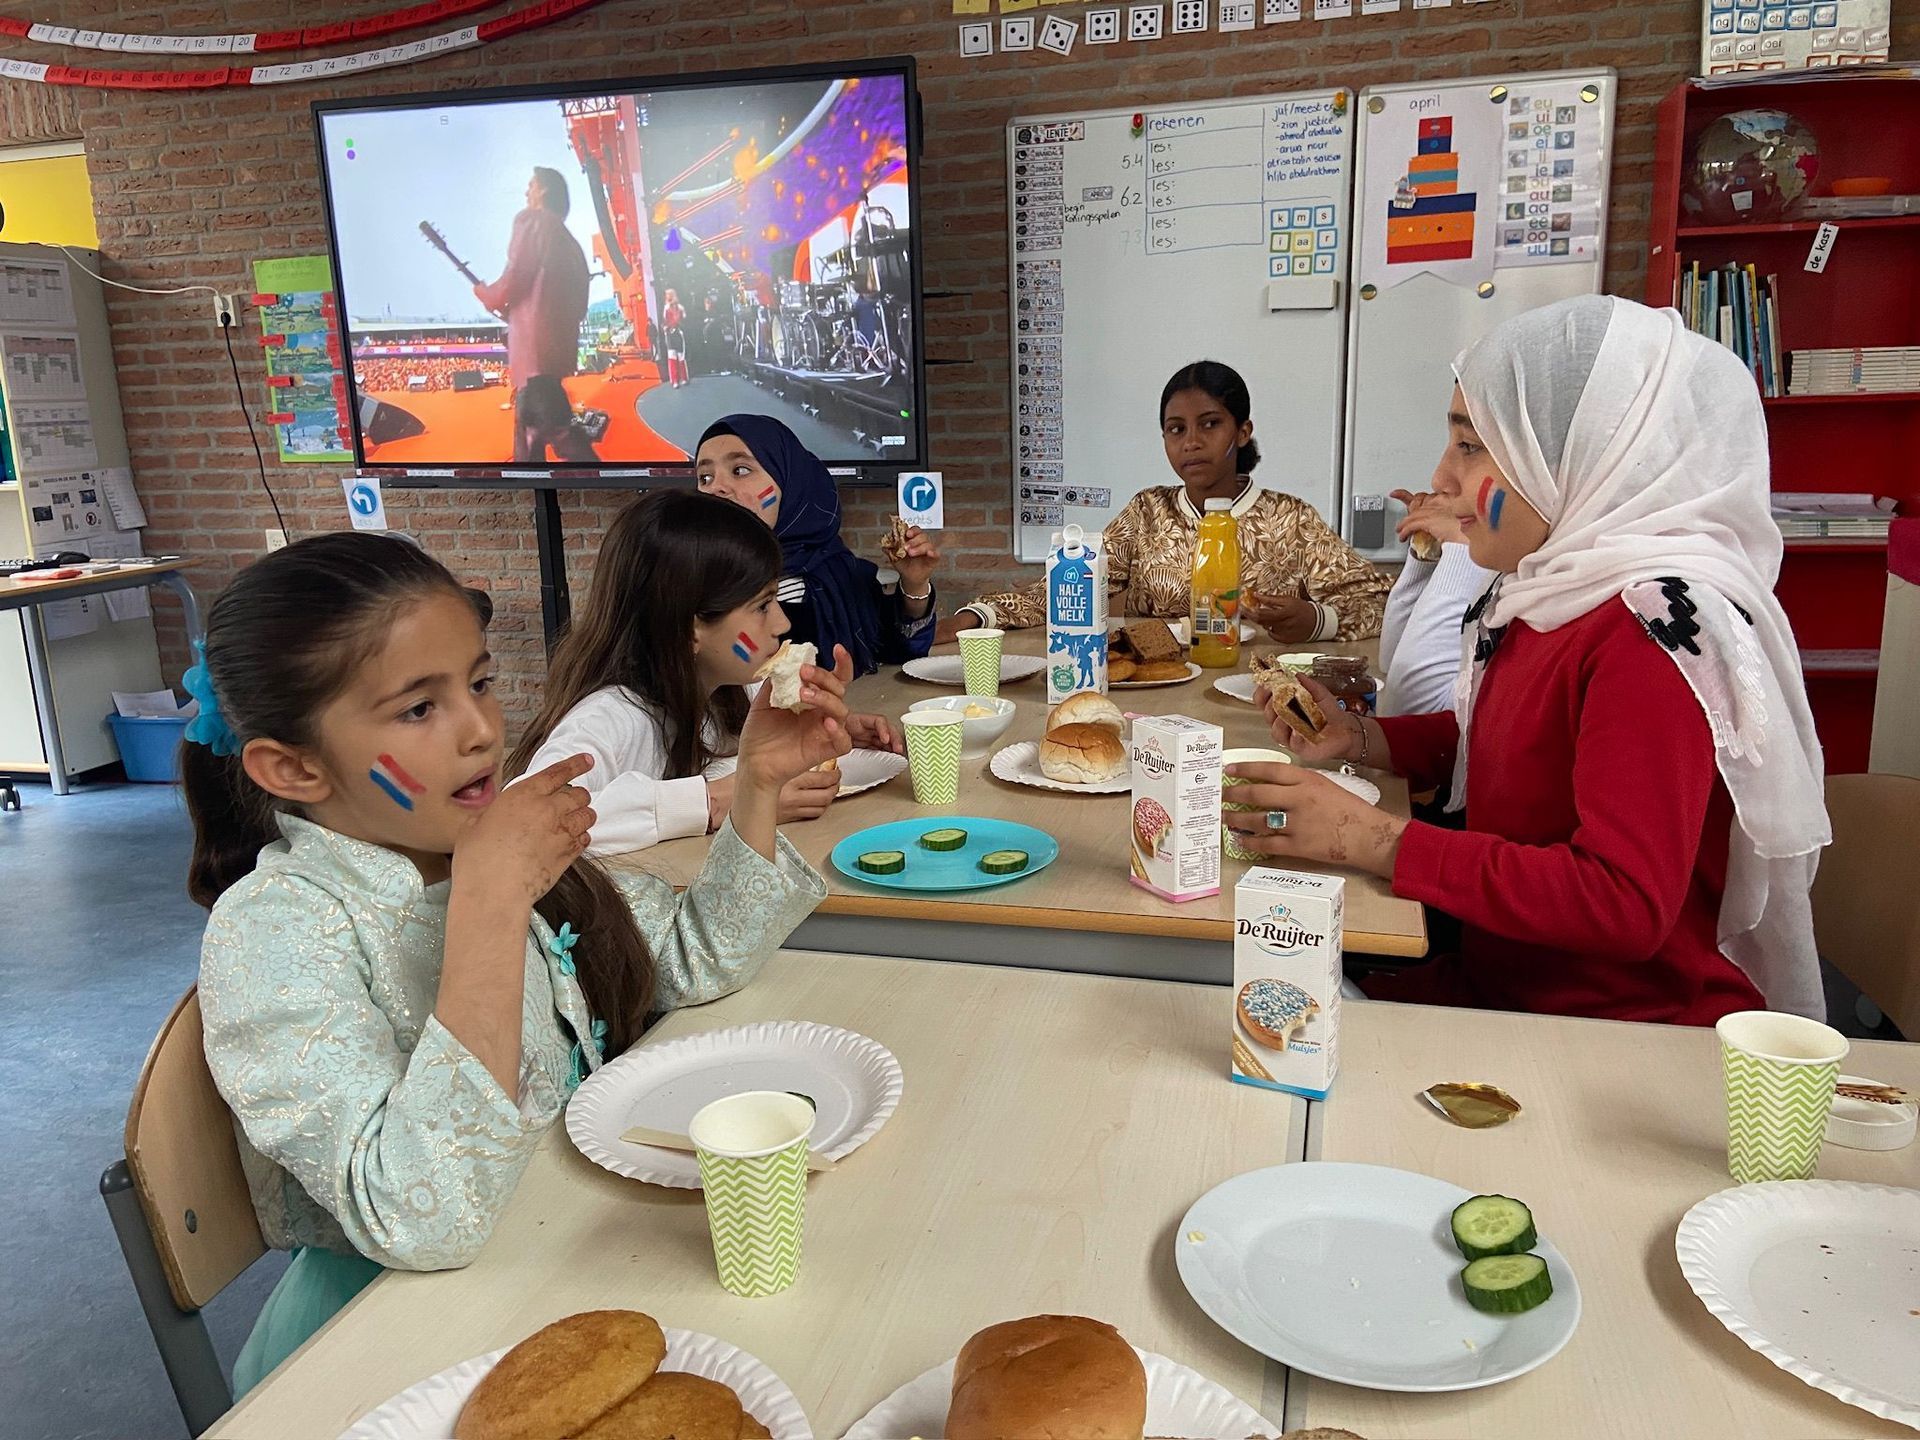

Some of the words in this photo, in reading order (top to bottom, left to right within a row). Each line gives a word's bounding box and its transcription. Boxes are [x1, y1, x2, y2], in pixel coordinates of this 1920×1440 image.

[1716, 18, 1729, 28] ng
[1744, 16, 1757, 26] nk
[1769, 13, 1782, 24] ch
[1791, 13, 1809, 23] sch
[58, 30, 68, 39] 12
[83, 33, 93, 42] 13
[107, 36, 117, 44] 14
[130, 36, 140, 44] 15
[152, 37, 162, 45] 16
[173, 38, 183, 47] 17
[195, 39, 204, 48] 18
[217, 38, 226, 47] 19
[239, 37, 250, 46] 20
[10, 63, 21, 72] 59
[30, 65, 41, 75] 60
[258, 69, 268, 78] 71
[280, 67, 290, 76] 72
[302, 64, 313, 74] 73
[324, 61, 335, 70] 74
[346, 57, 356, 66] 75
[369, 52, 379, 61] 76
[392, 49, 403, 58] 77
[414, 42, 426, 53] 78
[437, 37, 449, 47] 79
[460, 30, 472, 40] 80
[1715, 44, 1731, 53] aai
[1739, 43, 1756, 52] ooi
[1410, 95, 1441, 113] april
[1534, 98, 1552, 110] eu
[1149, 114, 1205, 131] rekenen
[1536, 110, 1550, 123] ui
[1046, 128, 1070, 140] LENTE
[1533, 123, 1551, 135] oe
[1151, 142, 1172, 154] les:
[1536, 136, 1549, 149] ei
[1152, 159, 1175, 173] les:
[1535, 163, 1549, 177] ie
[1152, 179, 1175, 192] les:
[1152, 195, 1175, 207] les:
[1529, 190, 1551, 202] au
[1528, 202, 1549, 214] aa
[1152, 216, 1176, 230] les:
[1278, 213, 1283, 222] k
[1321, 212, 1327, 220] s
[1528, 215, 1549, 228] ee
[1152, 235, 1176, 248] les:
[1296, 238, 1308, 246] aa
[1527, 230, 1548, 243] oo
[1814, 227, 1832, 251] kast
[1527, 243, 1549, 256] uu
[1276, 262, 1283, 272] p
[1298, 261, 1305, 269] e
[1321, 259, 1327, 267] v
[1809, 255, 1822, 269] de
[1038, 298, 1053, 306] TAAL
[1058, 584, 1084, 596] HALF
[1056, 596, 1087, 609] VOLLE
[1058, 609, 1085, 622] MELK
[1236, 918, 1261, 938] De
[1261, 922, 1325, 949] Ruijter
